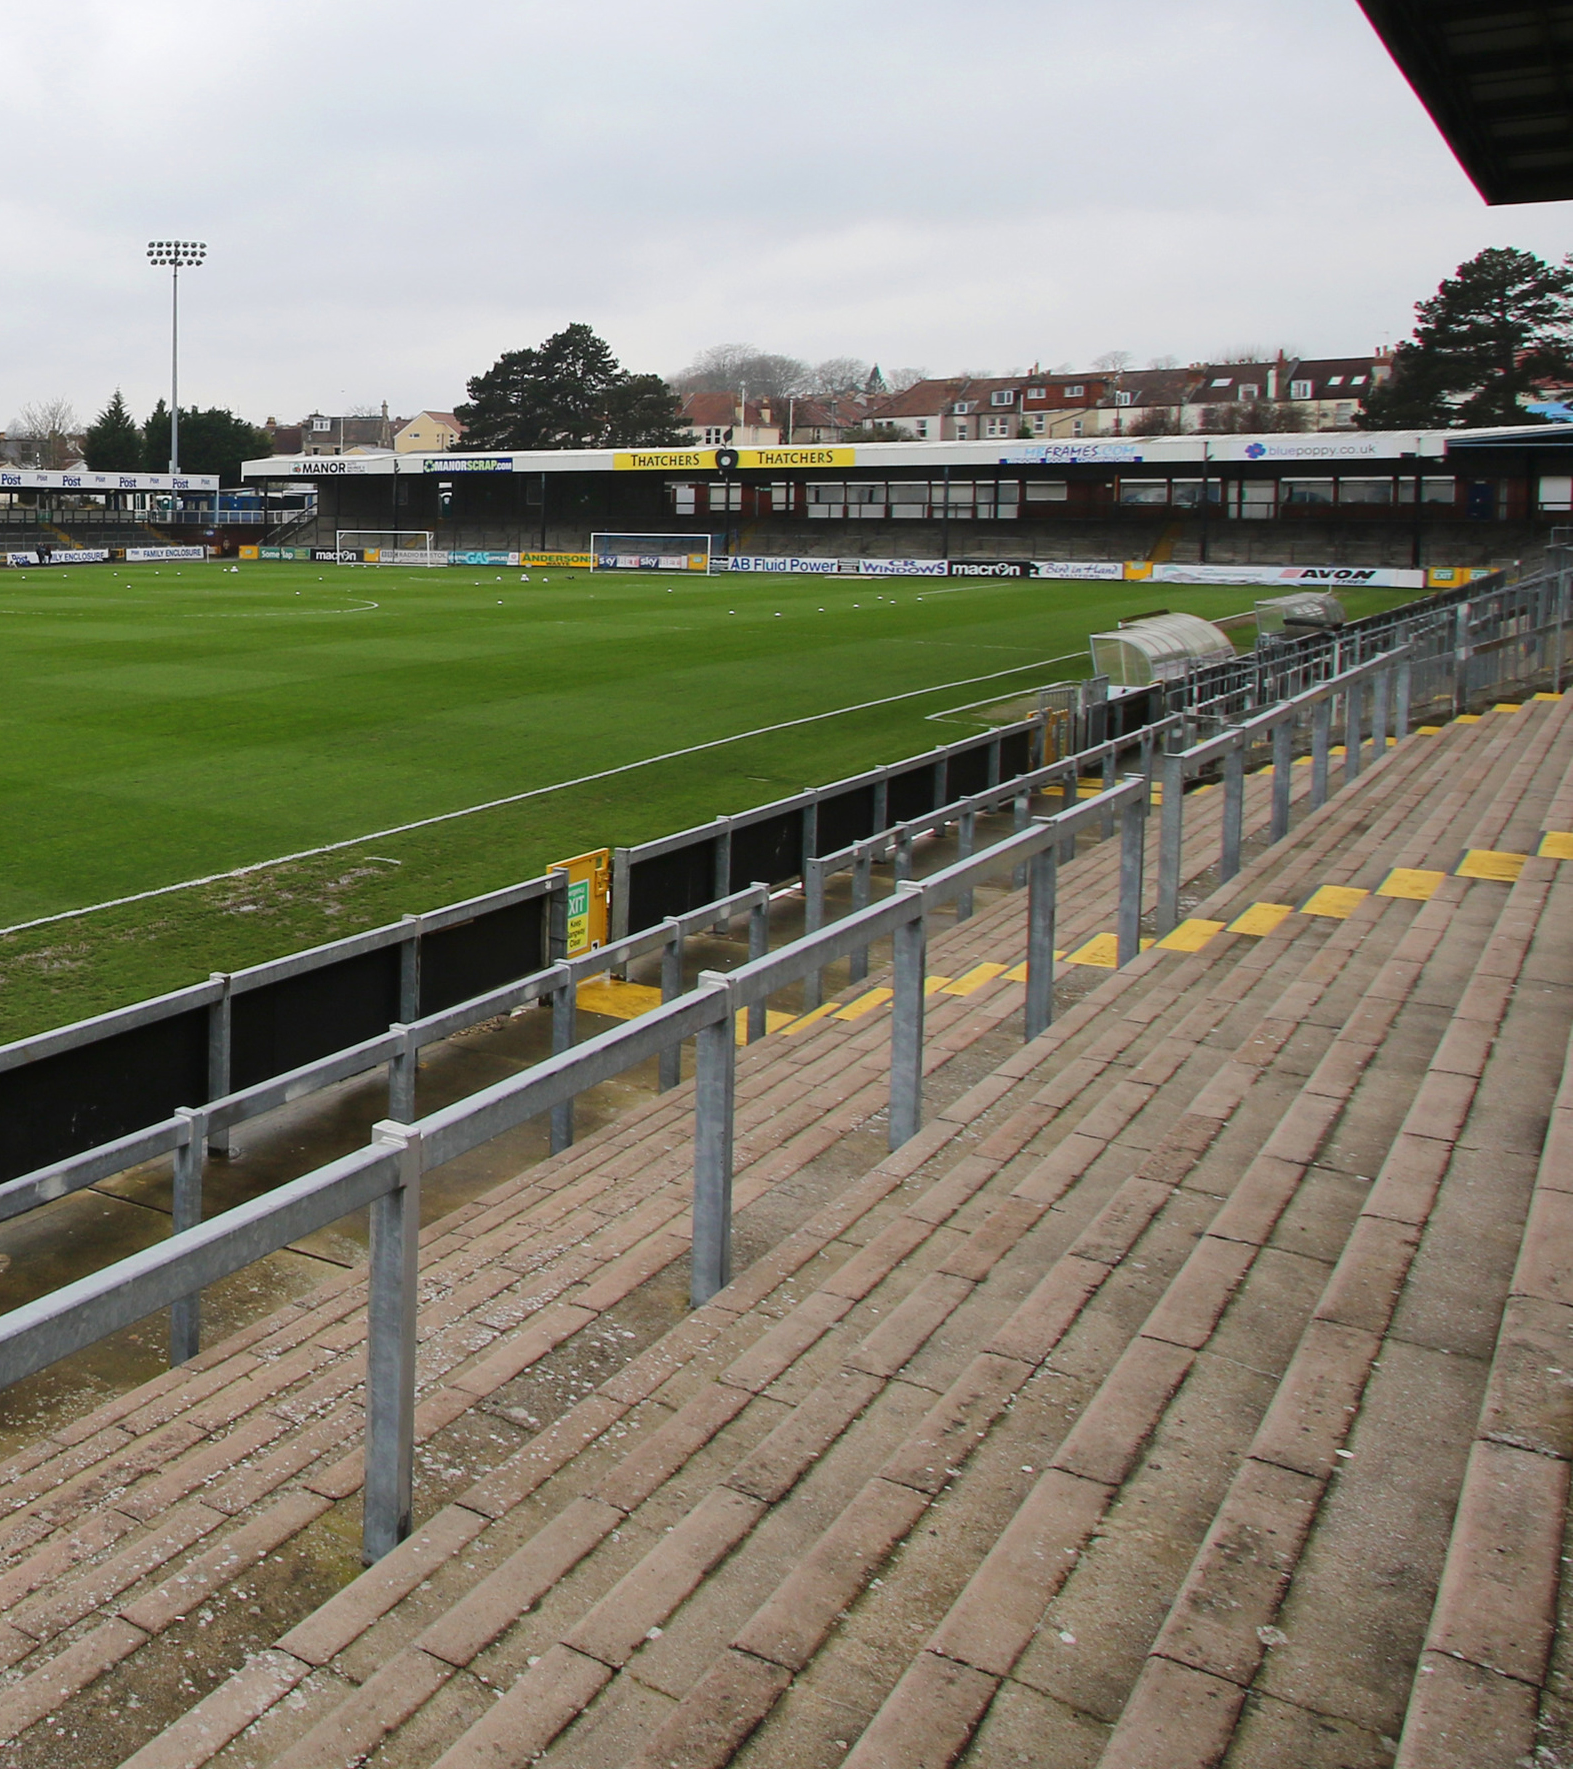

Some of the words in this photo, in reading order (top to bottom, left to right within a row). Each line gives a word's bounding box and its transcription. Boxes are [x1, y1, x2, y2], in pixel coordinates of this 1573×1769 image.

[1269, 444, 1375, 458] bluepoppy.co.uk
[631, 453, 700, 467] THATCHERS
[757, 450, 834, 465] THATCHERS
[303, 463, 346, 473] MANOR
[1, 473, 21, 485] Post
[62, 475, 81, 487] Post
[119, 477, 137, 488] Post
[172, 478, 189, 489] Post
[64, 552, 105, 561] ENCLOSURE
[143, 550, 164, 558] FAMILY
[166, 548, 202, 557] ENCLOSURE
[465, 552, 490, 564] GAS
[599, 556, 616, 566] sky
[640, 556, 657, 567] sky
[731, 557, 751, 570] AB
[754, 558, 786, 571] Fluid
[790, 558, 836, 572] Power
[862, 561, 946, 575] WINDOWS
[952, 562, 1020, 576] macron
[1046, 563, 1070, 574] Bird
[1071, 564, 1082, 574] in
[1084, 563, 1118, 575] Hand
[1300, 568, 1377, 580] AVON
[1433, 572, 1452, 580] EXIT
[568, 895, 584, 917] XIT
[570, 920, 582, 928] Keep
[569, 939, 581, 948] Clear
